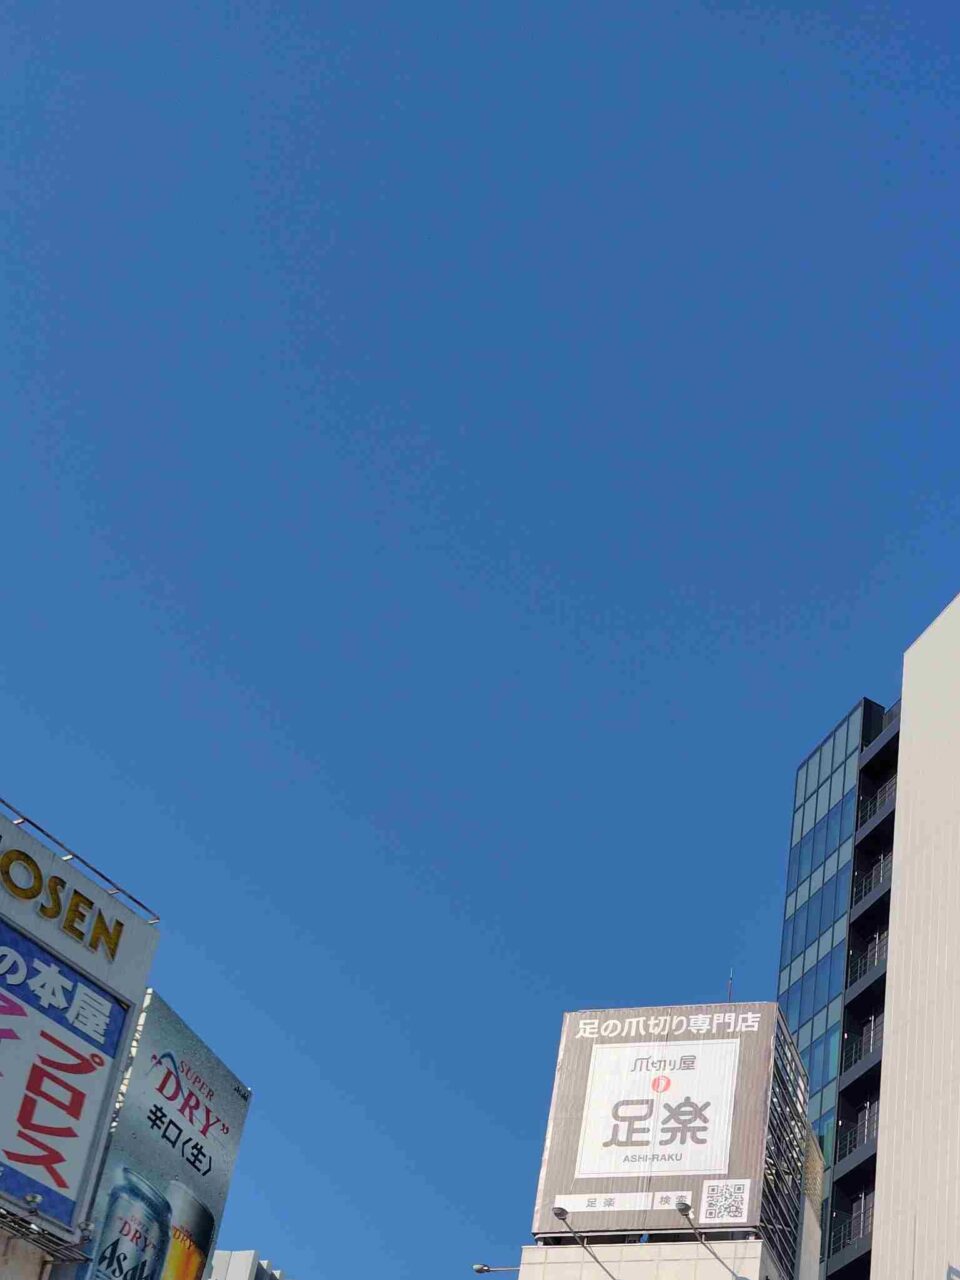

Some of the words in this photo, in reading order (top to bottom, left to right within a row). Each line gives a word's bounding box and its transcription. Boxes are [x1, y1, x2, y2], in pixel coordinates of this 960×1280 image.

[0, 836, 125, 964] OSEN
[575, 1012, 762, 1039] 足の爪切り専門店
[178, 1060, 216, 1101] SUPER
[630, 1055, 697, 1072] 爪切り屋
[2, 1029, 105, 1190] プロレス
[602, 1096, 711, 1149] 足楽
[623, 1153, 683, 1163] ASHI-RAKU
[585, 1197, 616, 1208] 足楽
